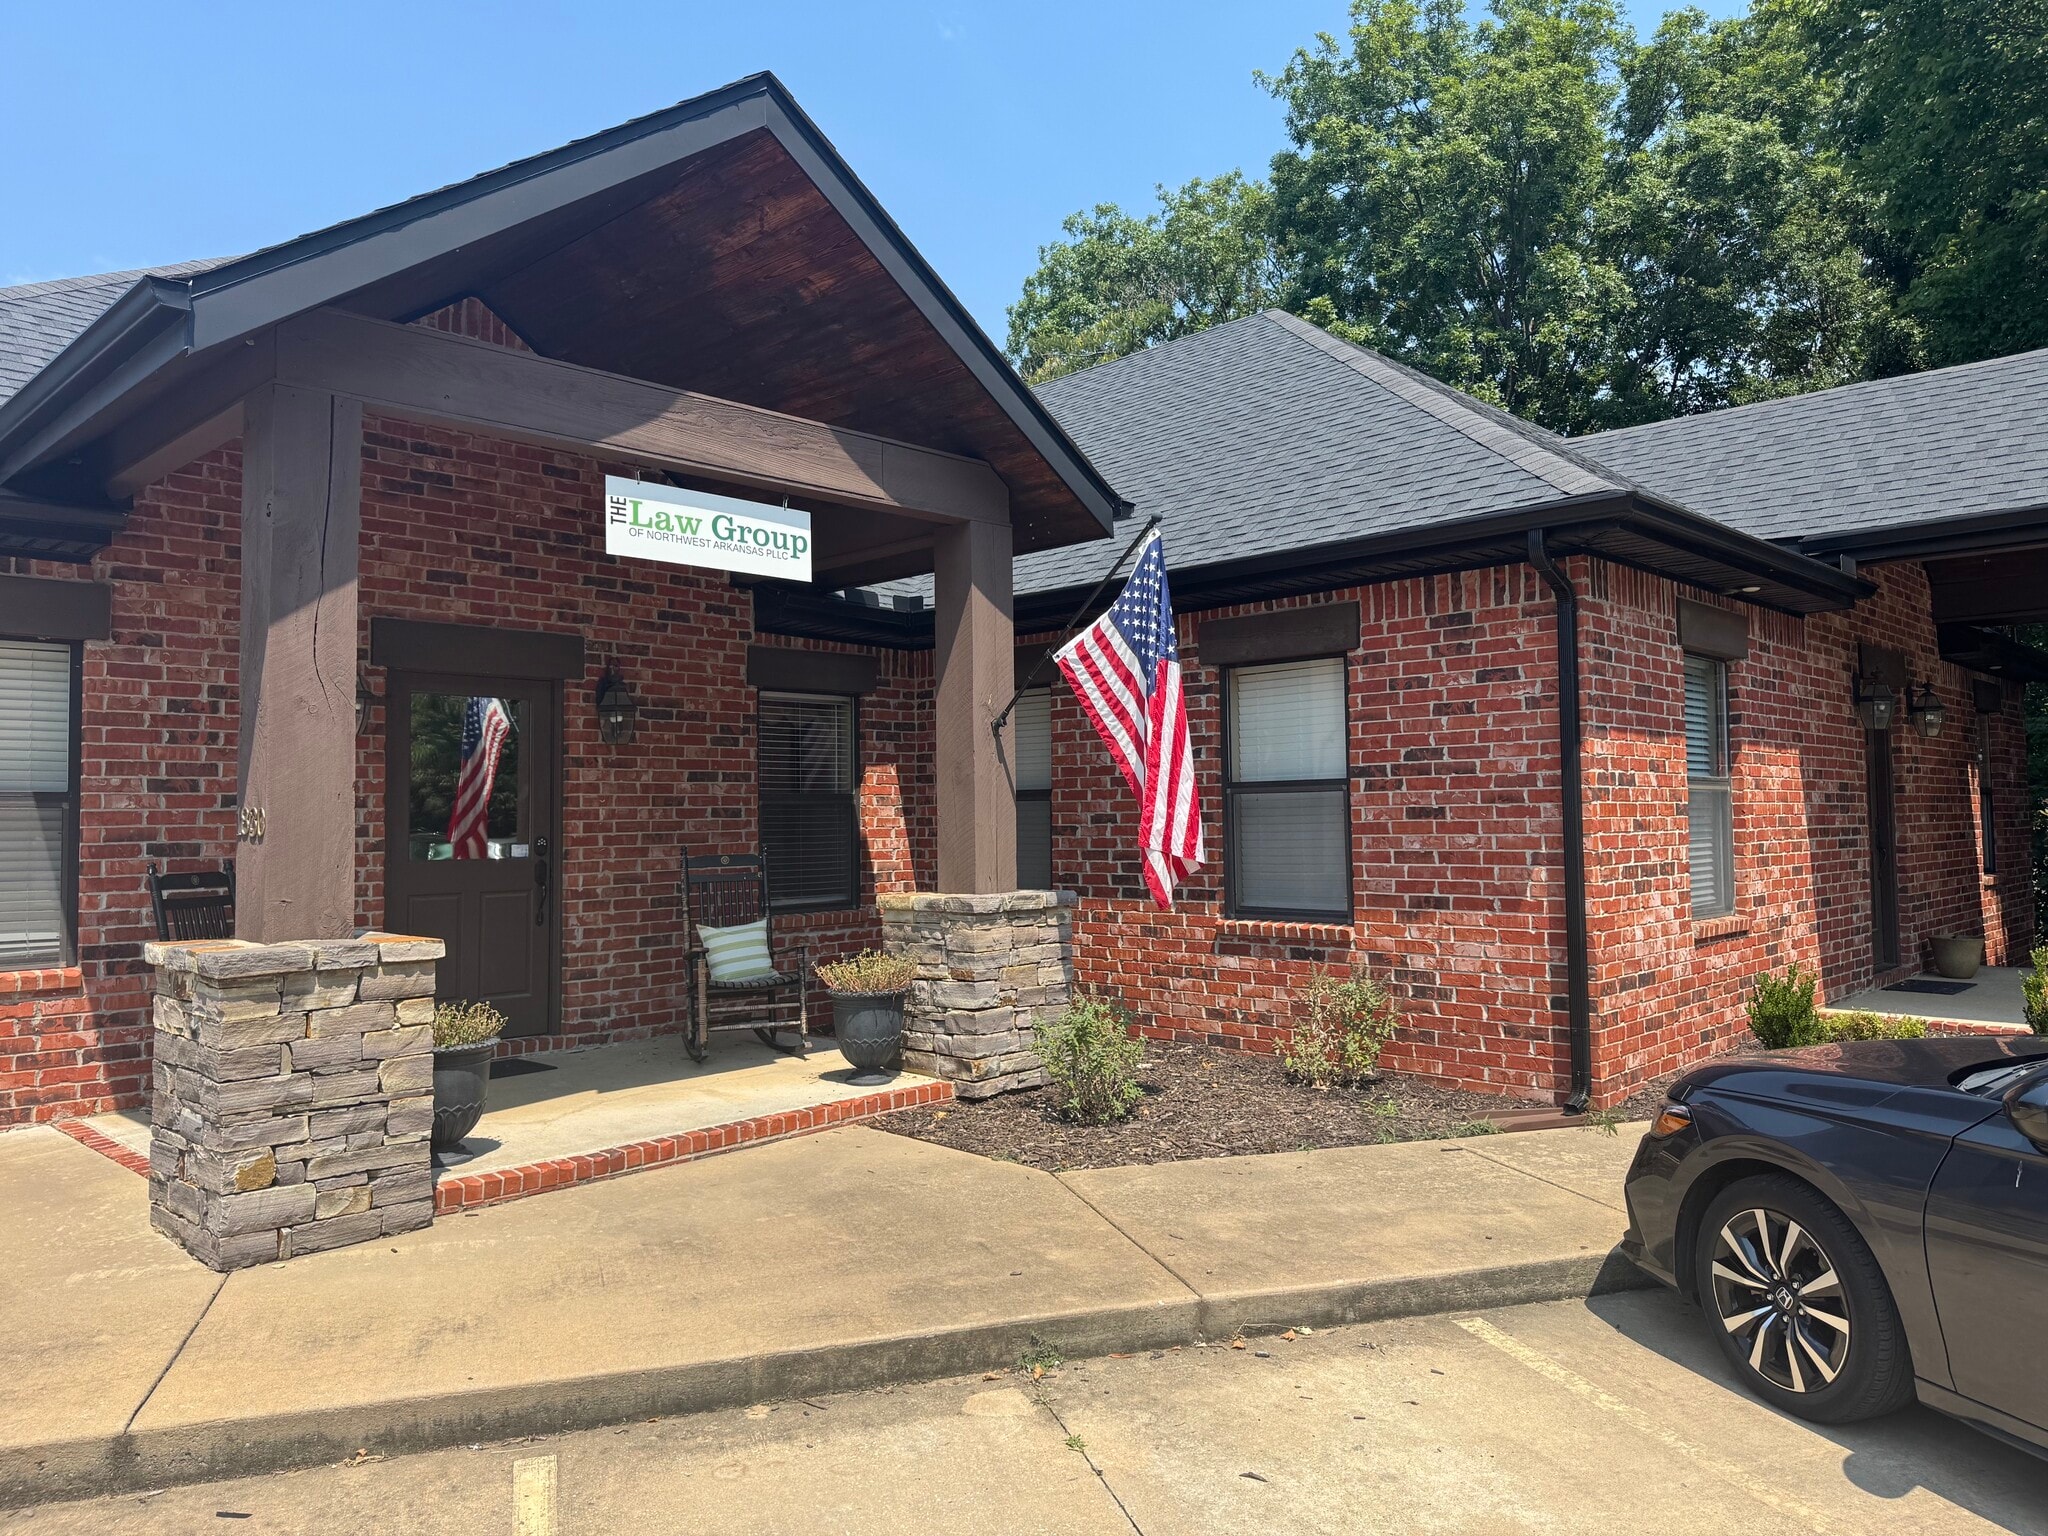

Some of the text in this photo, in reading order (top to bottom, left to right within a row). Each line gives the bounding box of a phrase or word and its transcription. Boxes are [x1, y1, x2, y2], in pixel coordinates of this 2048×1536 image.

[610, 495, 627, 525] THE
[628, 499, 808, 560] Law Group
[628, 527, 789, 561] OF NORTHWEST ARKANSAS PLLC
